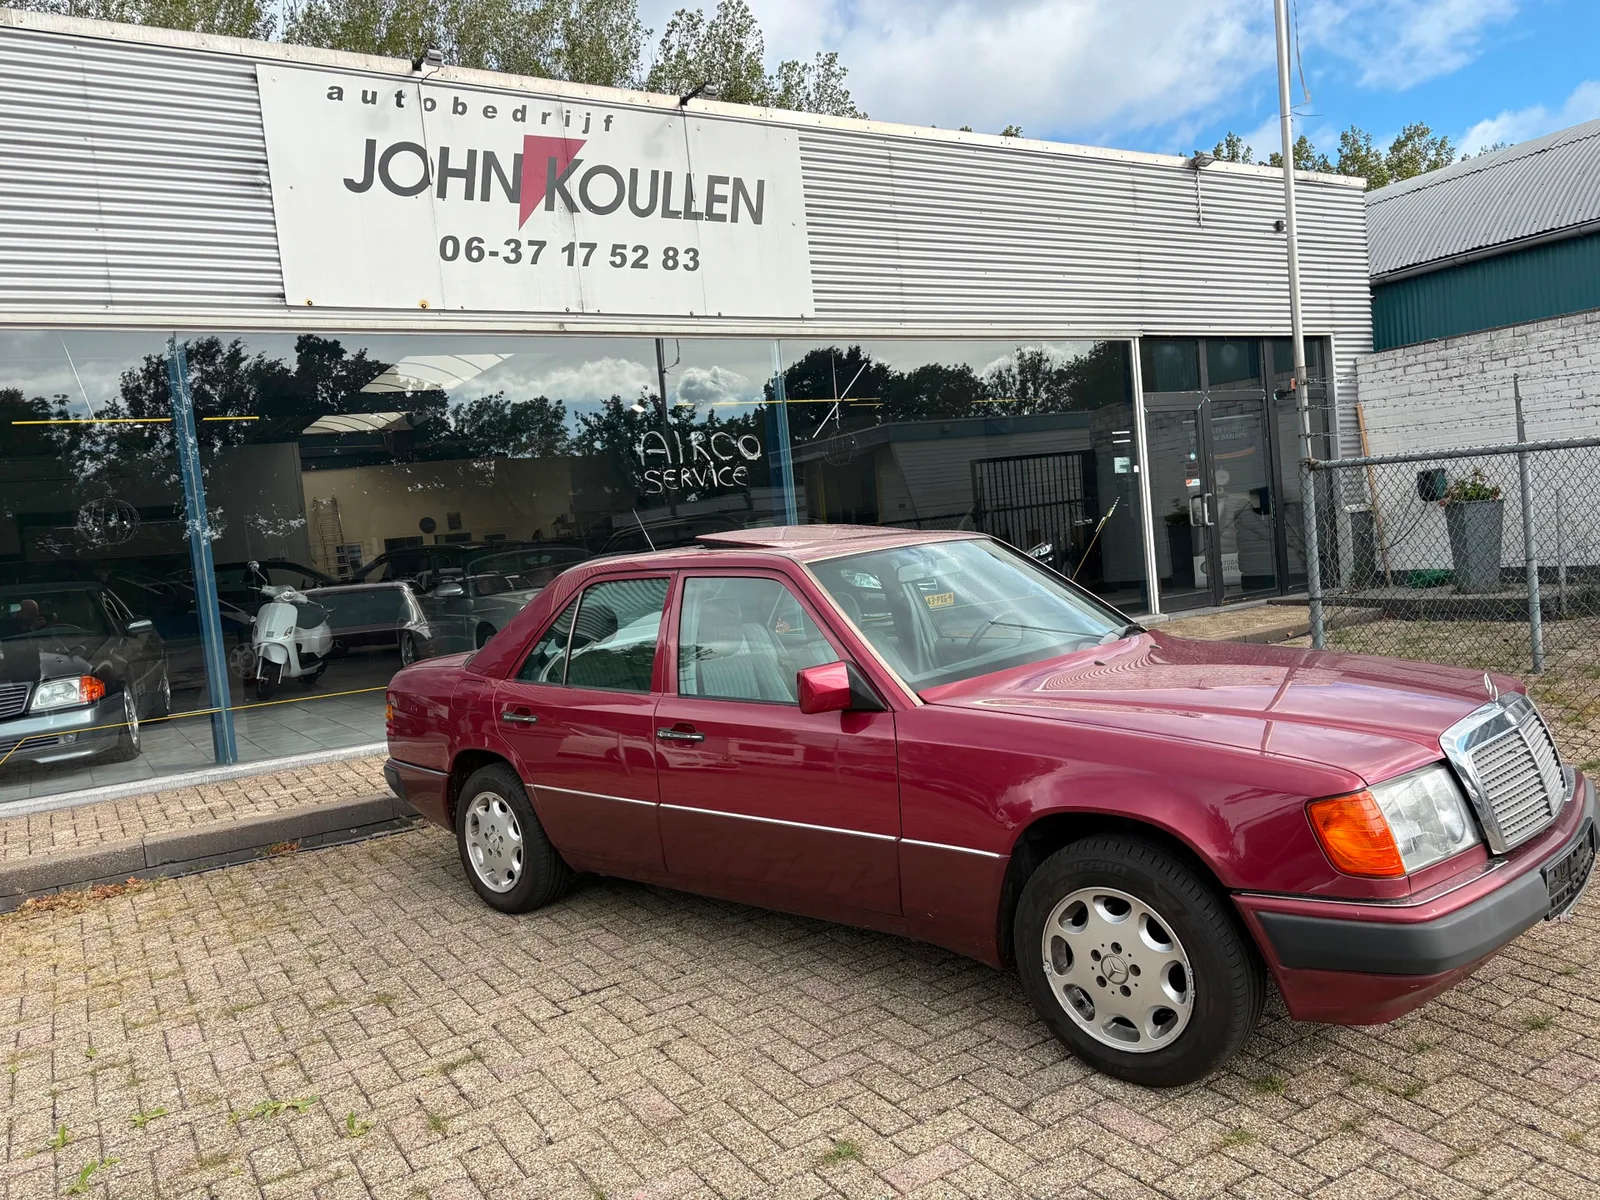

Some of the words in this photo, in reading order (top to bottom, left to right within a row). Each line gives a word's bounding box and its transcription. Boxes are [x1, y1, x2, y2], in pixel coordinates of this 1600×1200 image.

[326, 85, 613, 134] autobedrijf
[343, 138, 524, 204] JOHN
[544, 156, 765, 226] KOULLEN
[439, 235, 547, 265] 06-37
[561, 241, 598, 267] 17
[609, 243, 649, 269] 52
[662, 246, 700, 272] 83
[640, 431, 762, 466] AIRCO
[644, 466, 748, 494] SERVICE
